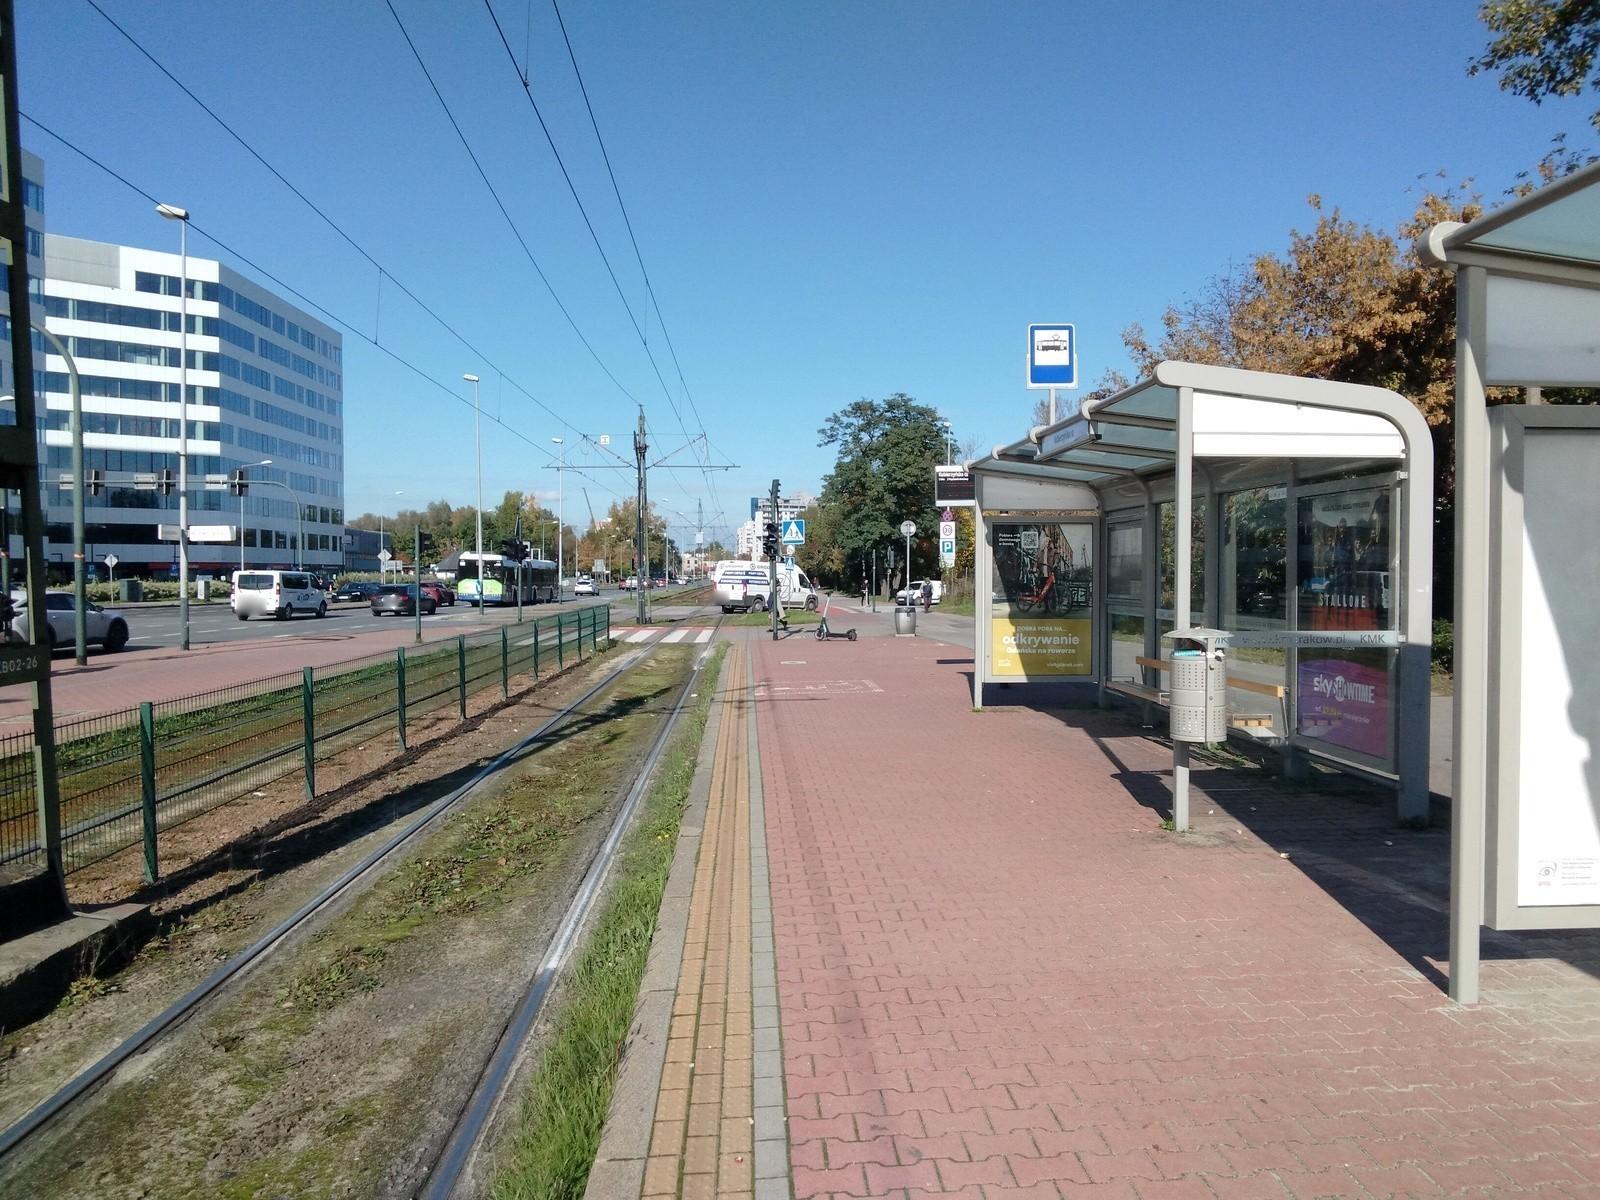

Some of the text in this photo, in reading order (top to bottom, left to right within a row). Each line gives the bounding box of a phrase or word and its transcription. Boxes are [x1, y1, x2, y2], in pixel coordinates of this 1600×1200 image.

[1319, 594, 1366, 608] STALLONE
[1002, 633, 1080, 648] odkrywanie
[1360, 634, 1385, 644] KMK
[0, 655, 38, 674] B02-26
